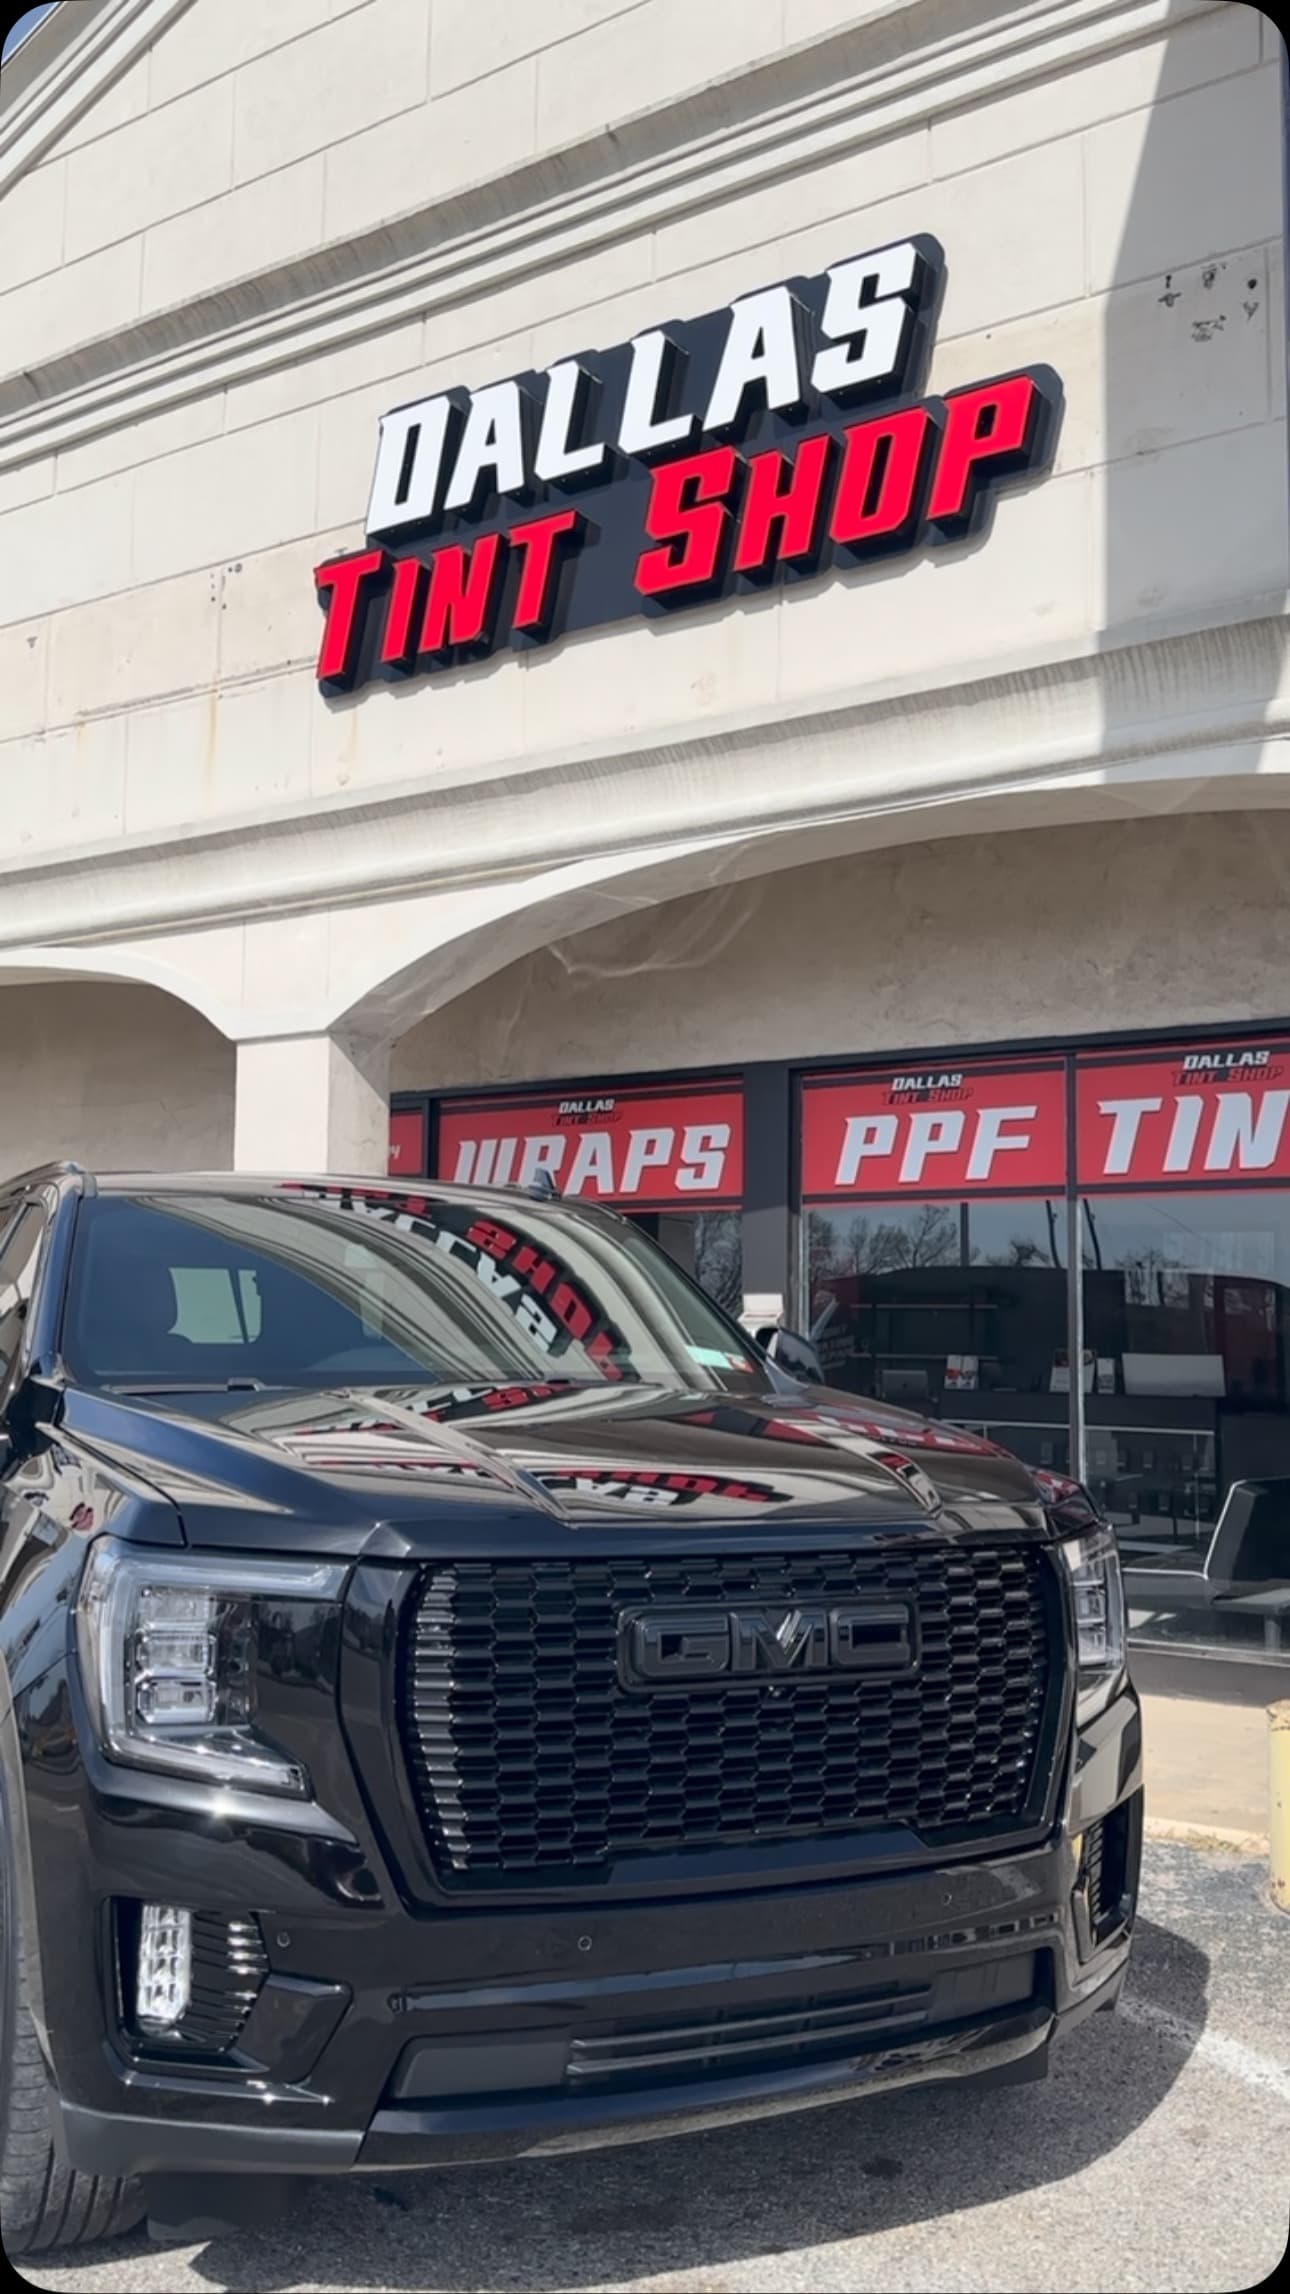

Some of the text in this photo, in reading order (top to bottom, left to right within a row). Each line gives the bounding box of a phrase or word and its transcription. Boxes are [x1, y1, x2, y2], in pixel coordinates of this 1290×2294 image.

[366, 243, 917, 536] DALLAS
[314, 375, 1036, 680] TINT SHOP
[891, 1073, 963, 1091] DALLAS
[1171, 1065, 1284, 1087] TINT SHOP
[1183, 1050, 1270, 1070] DALLAS
[558, 1098, 615, 1114] DALLAS
[834, 1105, 1038, 1186] PPF
[635, 1605, 911, 1678] GMC
